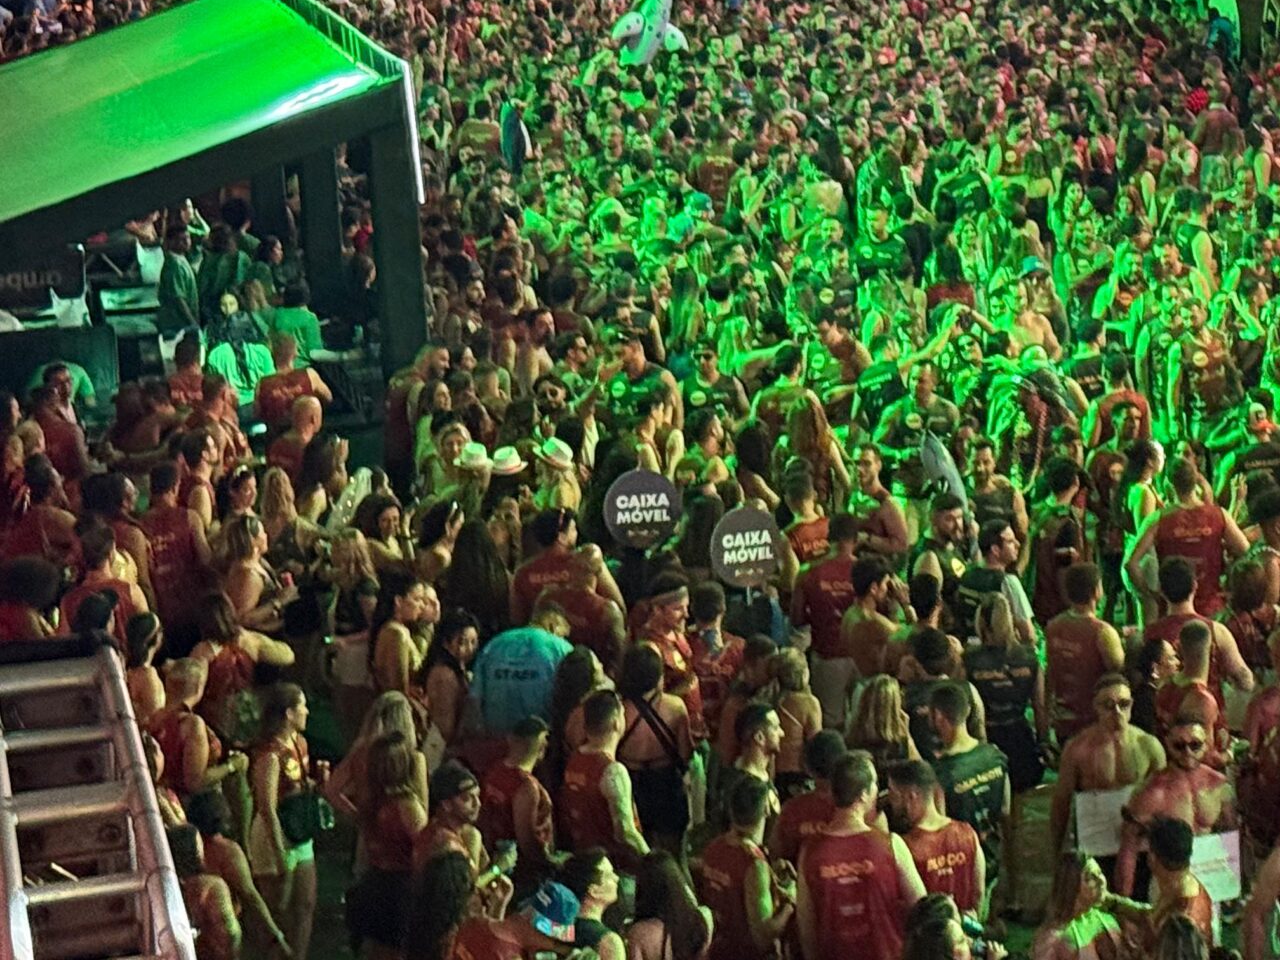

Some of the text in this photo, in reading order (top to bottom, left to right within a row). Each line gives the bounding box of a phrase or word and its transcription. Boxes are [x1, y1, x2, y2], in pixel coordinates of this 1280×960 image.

[616, 492, 670, 510] CAIXA
[616, 507, 671, 525] MÓVEL
[722, 529, 773, 549] CAIXA
[722, 544, 774, 566] MÓVEL
